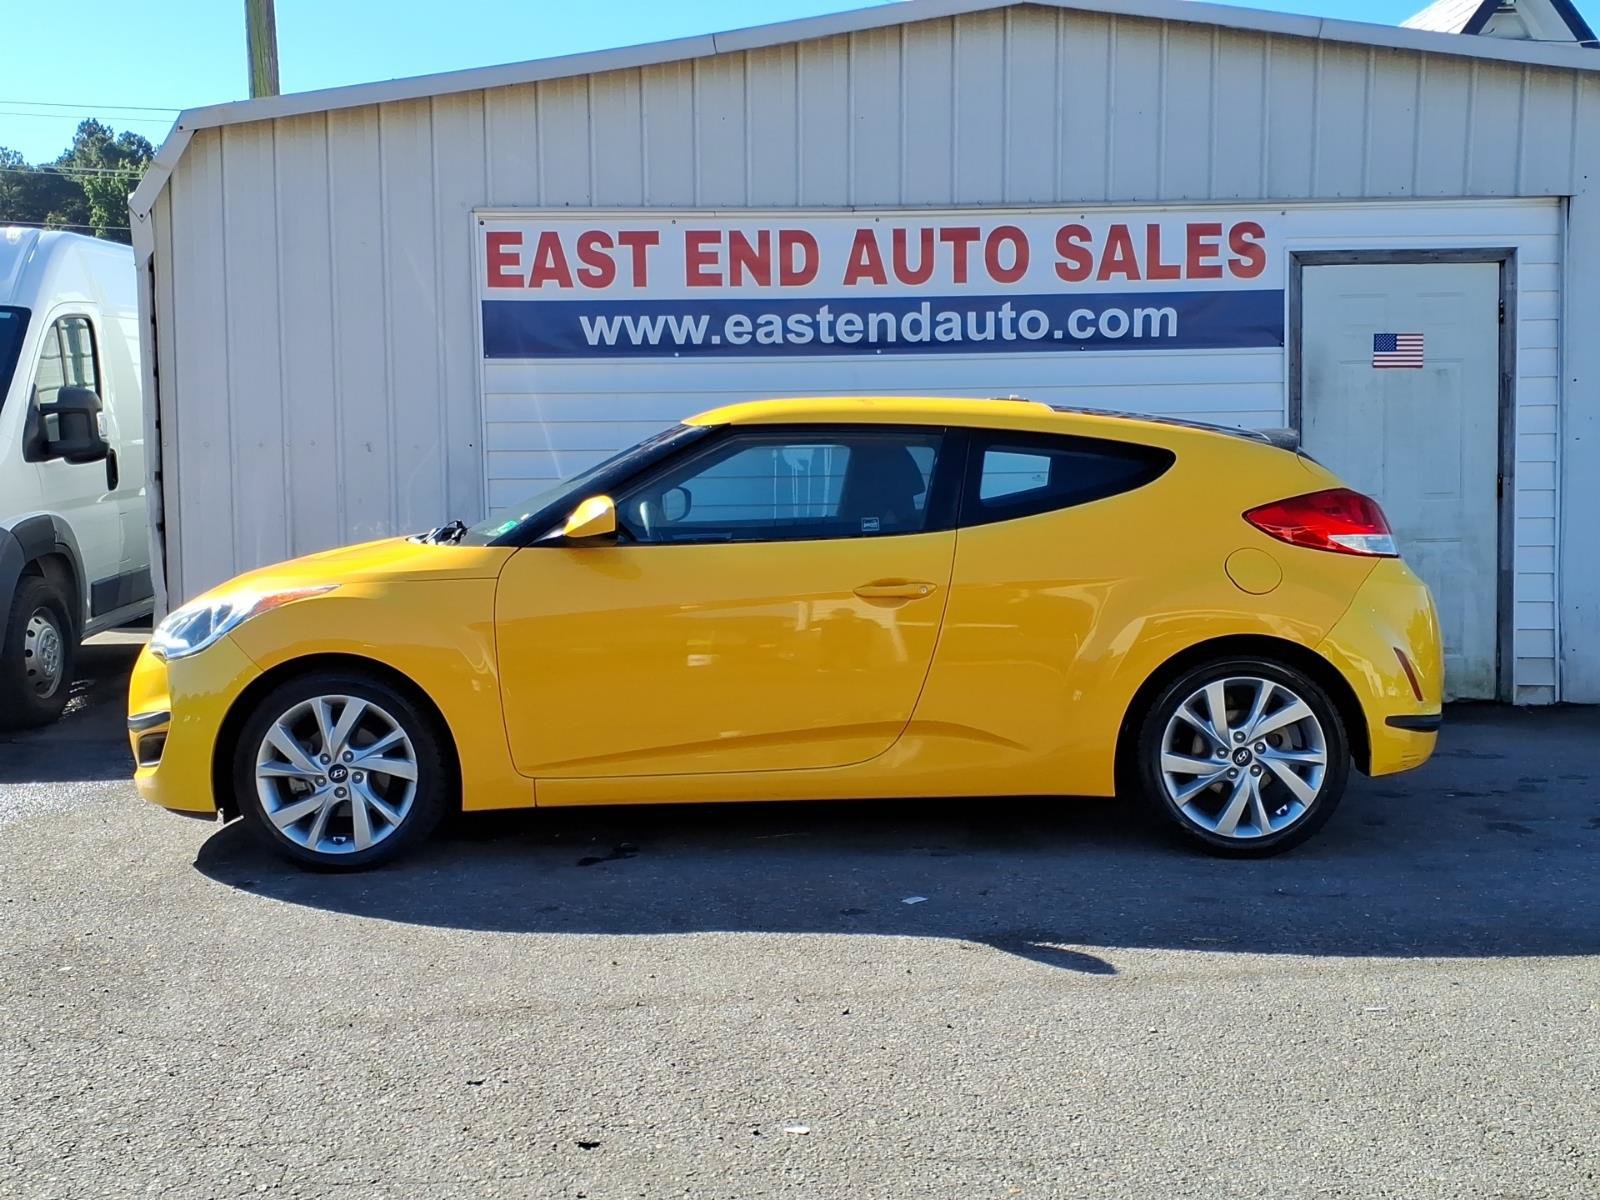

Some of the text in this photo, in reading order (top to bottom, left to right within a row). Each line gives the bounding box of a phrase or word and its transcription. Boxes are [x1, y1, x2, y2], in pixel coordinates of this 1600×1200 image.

[487, 221, 1267, 288] EAST END AUTO SALES
[579, 301, 1178, 345] www.eastendauto.com
